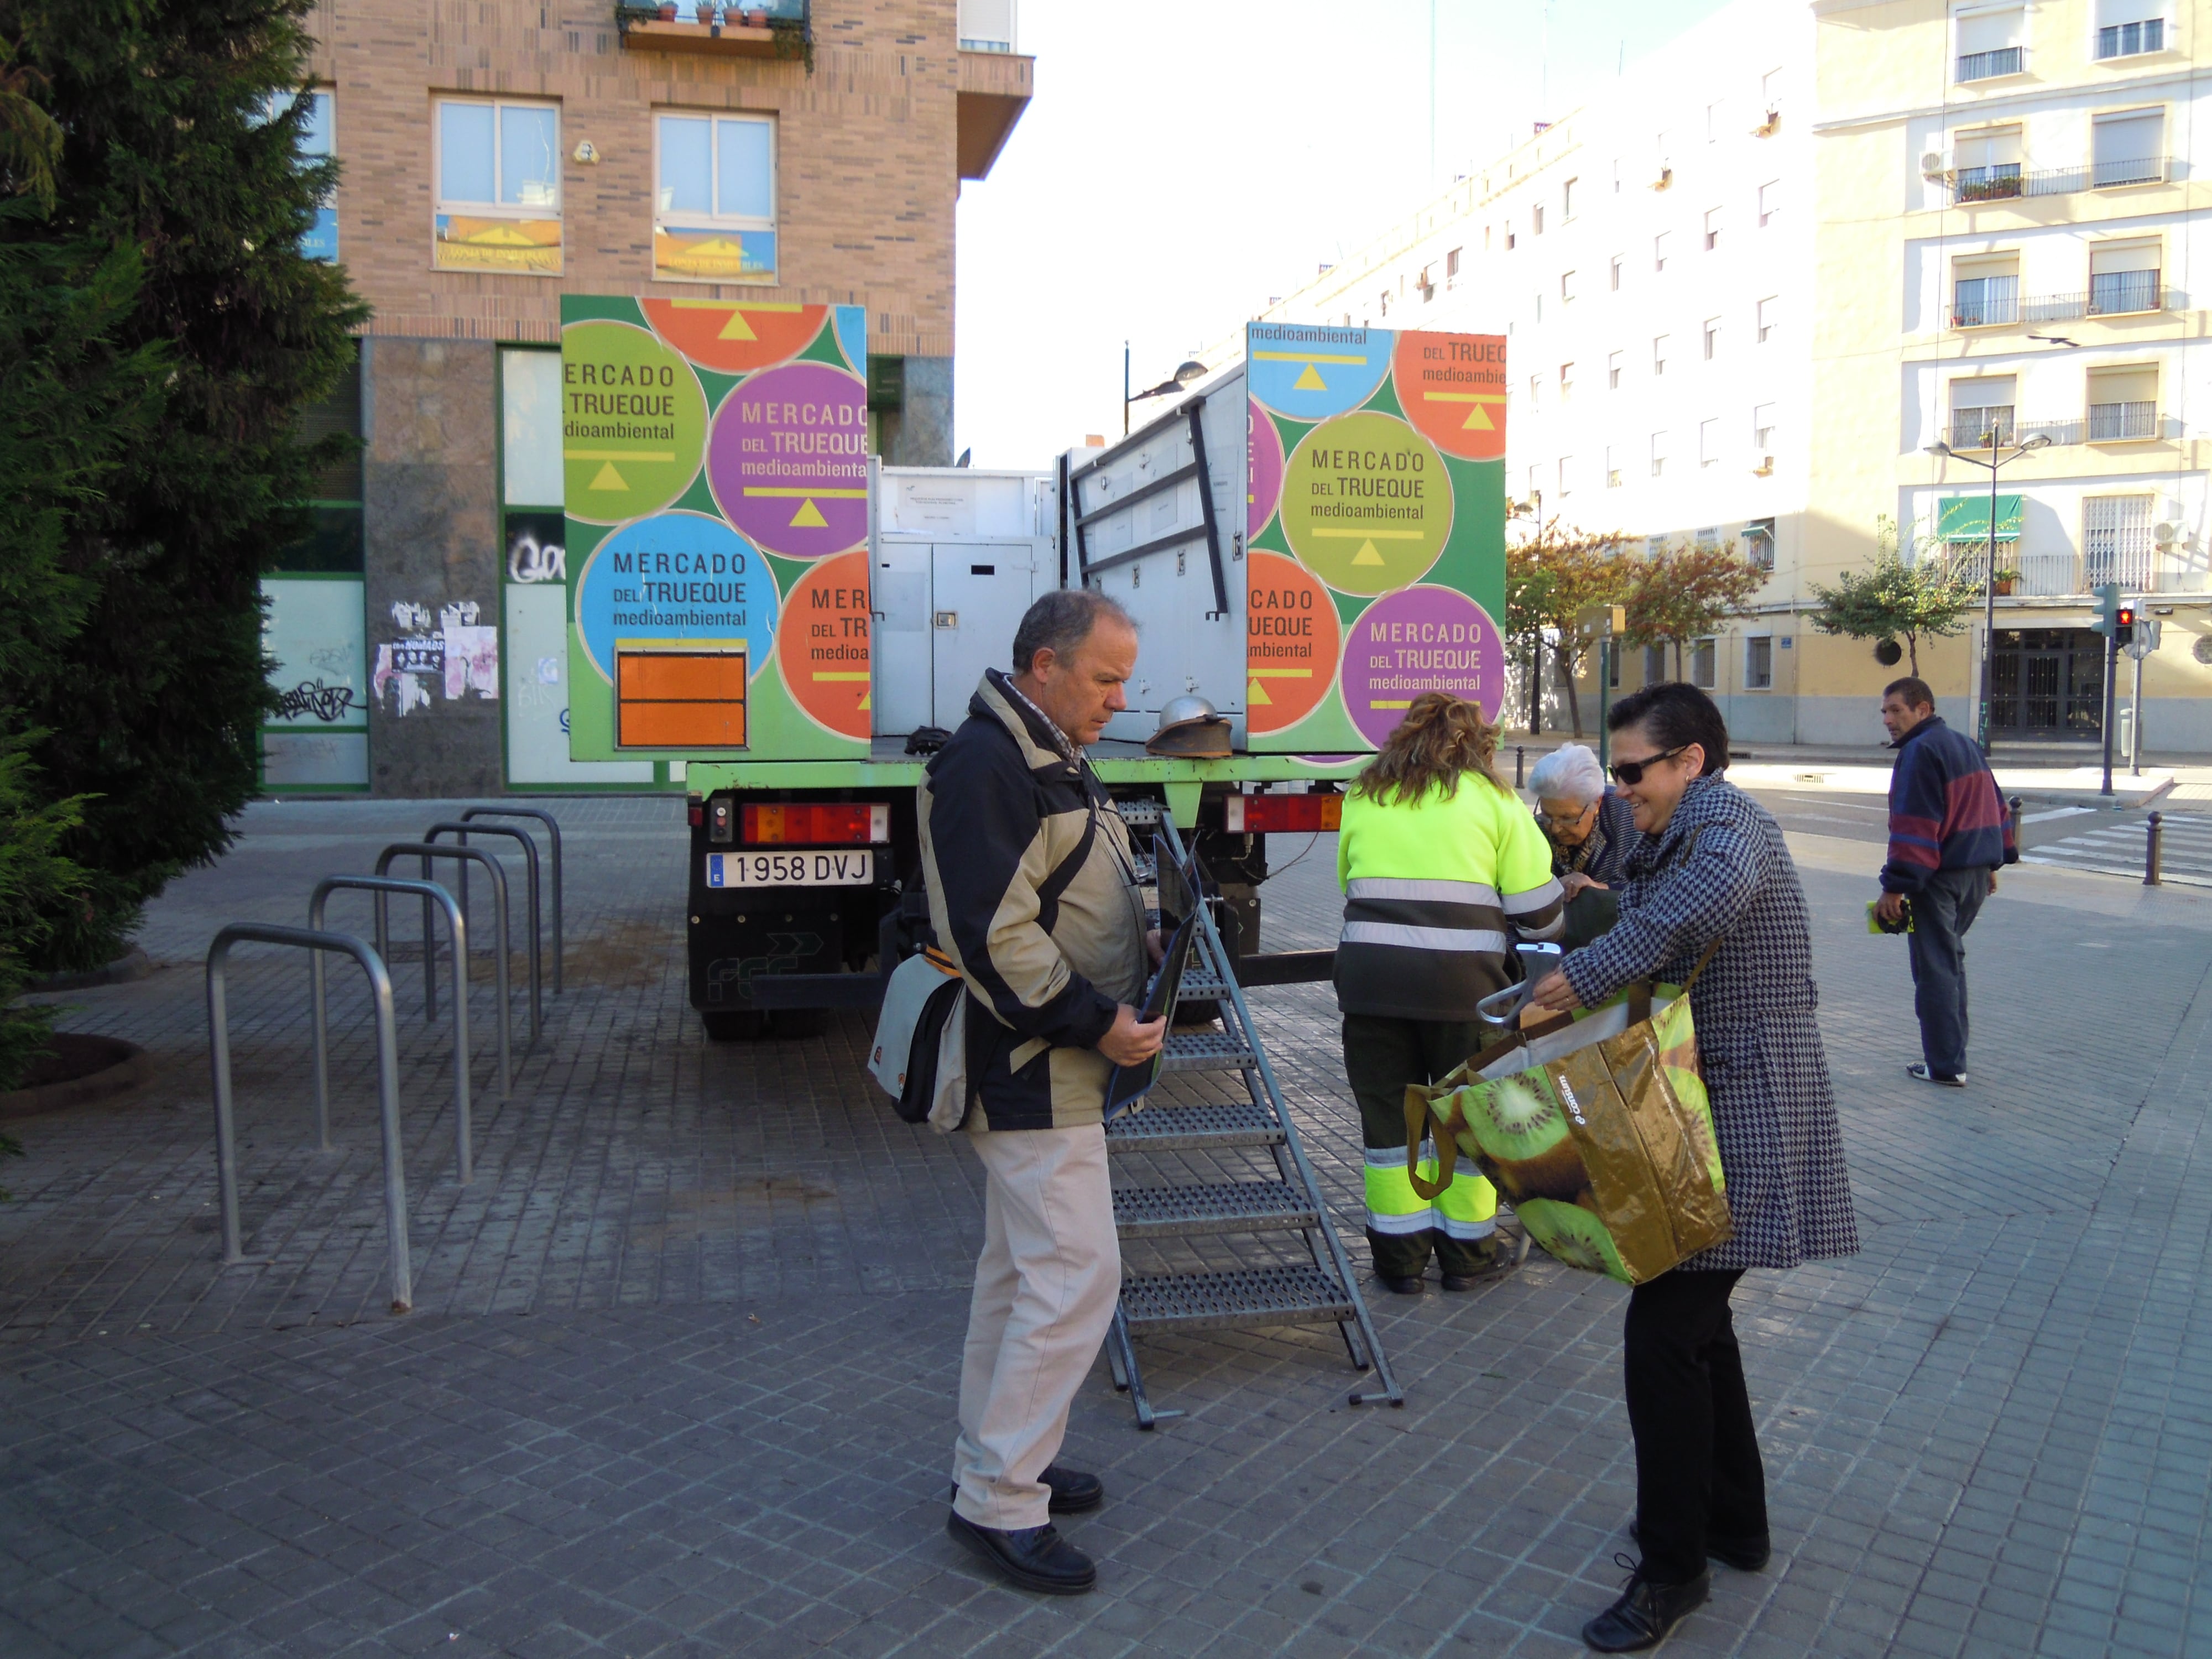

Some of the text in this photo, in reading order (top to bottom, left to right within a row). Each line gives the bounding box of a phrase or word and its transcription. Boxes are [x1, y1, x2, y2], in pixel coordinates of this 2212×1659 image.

[1251, 325, 1366, 345] medioambiental
[1424, 347, 1444, 359] DEL
[565, 363, 673, 387] ERCADO
[570, 393, 674, 416] TRUEQUE
[743, 403, 867, 426] MERCADO
[564, 421, 674, 439] dioambiental
[743, 432, 867, 455] DEL TRUEQUE
[742, 460, 867, 477] medioambienta
[1313, 450, 1423, 472] MERCADO
[1312, 477, 1423, 498] DEL TRUEQUE
[1311, 502, 1423, 519] medioambiental
[614, 553, 745, 573] MERCADO
[614, 582, 745, 603] DEL TRUEQUE
[812, 589, 865, 609] MER
[1251, 589, 1312, 609] CADO
[614, 610, 745, 625] medioambiental
[812, 618, 867, 637] DEL TR
[1249, 617, 1312, 635] UEQUE
[1371, 623, 1481, 643] MERCADO
[811, 644, 868, 660] medioa
[1249, 642, 1311, 657] mbiental
[1370, 650, 1480, 669] DEL TRUEQUE
[1370, 675, 1480, 690] medioambiental
[737, 854, 865, 881] 1958 DVJ
[1559, 1074, 1580, 1114] consum
